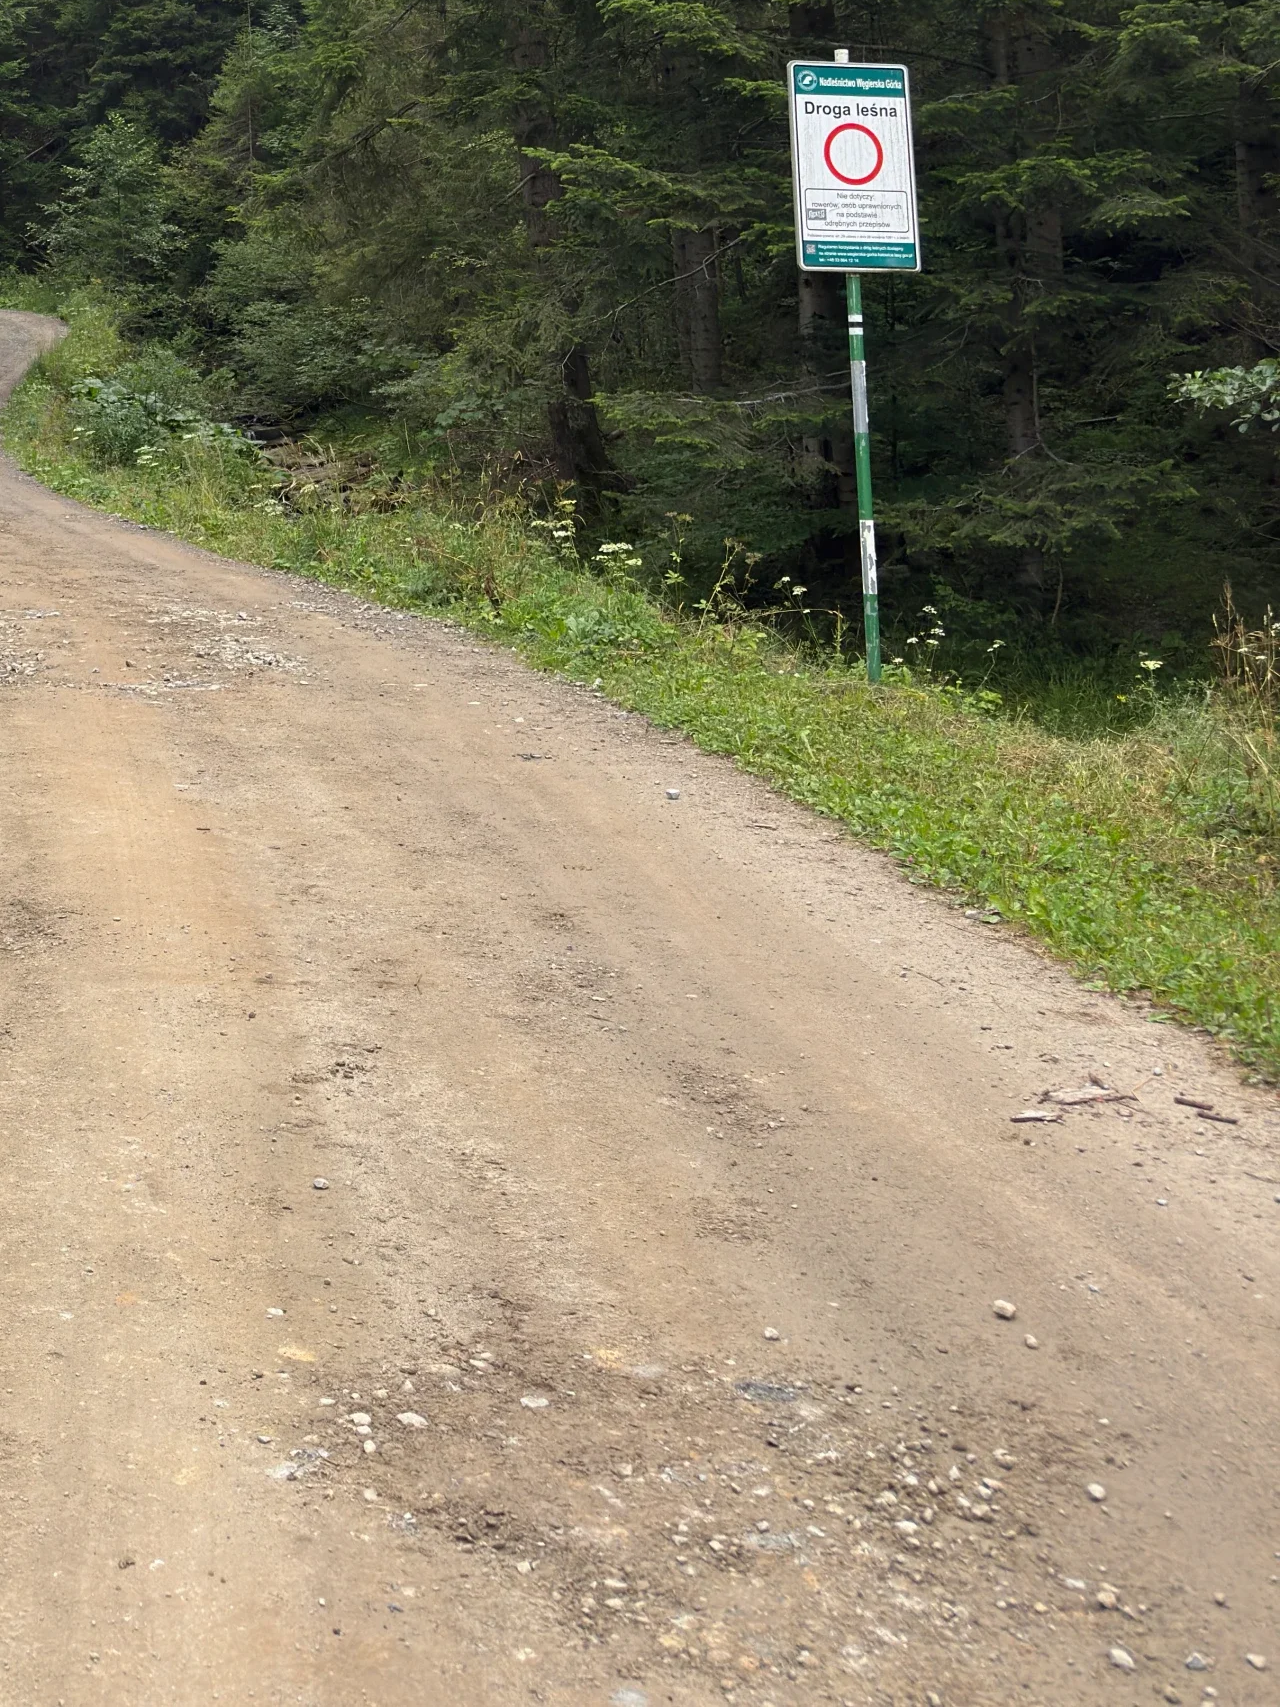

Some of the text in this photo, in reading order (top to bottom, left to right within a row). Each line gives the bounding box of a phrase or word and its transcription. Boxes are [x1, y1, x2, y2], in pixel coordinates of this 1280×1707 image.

[819, 77, 855, 88] Nadleśnictwo
[856, 78, 885, 90] Węgierska
[885, 79, 902, 89] Górka
[804, 101, 898, 119] Droga leśna
[858, 203, 902, 211] uprawnionych
